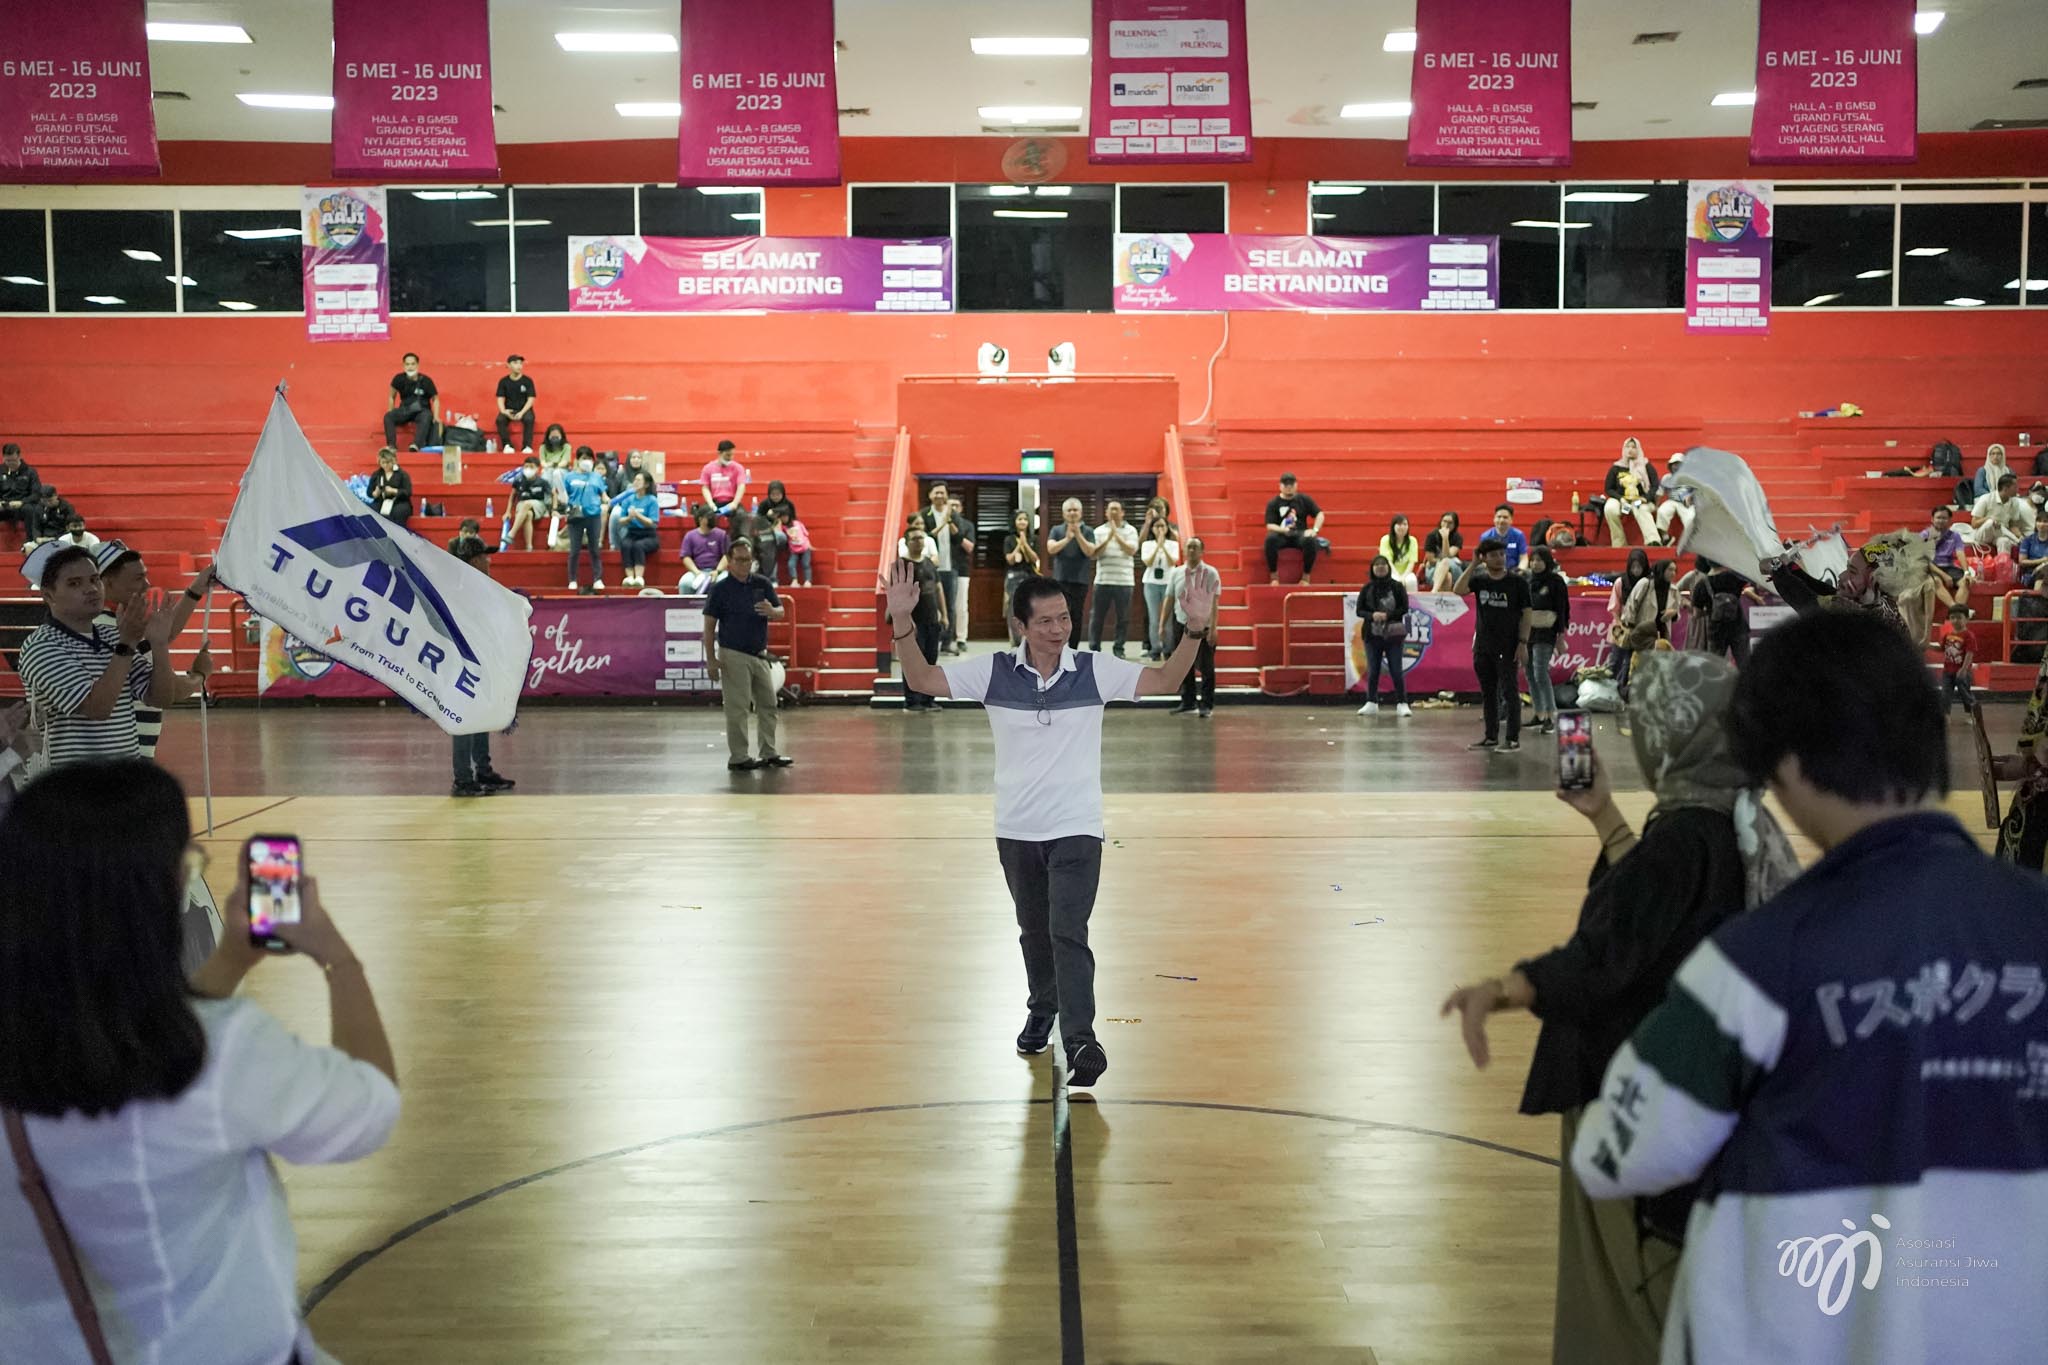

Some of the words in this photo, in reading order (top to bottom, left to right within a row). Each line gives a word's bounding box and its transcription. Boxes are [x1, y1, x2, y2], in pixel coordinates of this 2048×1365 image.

[1424, 54, 1435, 68] 6
[1441, 53, 1474, 67] MEI
[1492, 53, 1511, 67] 16
[1516, 53, 1558, 68] JUNI
[1766, 52, 1777, 66] 6
[1783, 51, 1816, 66] MEI
[1836, 50, 1854, 65] 16
[1860, 50, 1902, 64] JUNI
[4, 61, 15, 76] 6
[21, 61, 54, 76] MEI
[72, 61, 92, 76] 16
[97, 62, 141, 76] JUNI
[346, 63, 357, 78] 6
[363, 64, 396, 78] MEI
[415, 64, 433, 78] 16
[439, 64, 482, 79] JUNI
[693, 74, 703, 88] 6
[709, 74, 741, 88] MEI
[759, 73, 777, 88] 16
[783, 73, 825, 87] JUNI
[1468, 75, 1514, 89] 2023
[1811, 72, 1857, 87] 2023
[50, 83, 96, 98] 2023
[392, 86, 438, 100] 2023
[736, 95, 781, 110] 2023
[1790, 103, 1816, 111] HALL
[1836, 102, 1843, 110] B
[1451, 115, 1488, 123] GRAND
[1490, 115, 1528, 123] FUTSAL
[1794, 114, 1830, 122] GRAND
[1833, 113, 1872, 121] FUTSAL
[416, 127, 454, 135] FUTSAL
[717, 125, 742, 133] HALL
[1781, 125, 1799, 133] NYI
[1802, 125, 1838, 133] AGENG
[1841, 124, 1883, 132] SERANG
[84, 136, 127, 144] SERANG
[721, 136, 757, 144] GRAND
[1437, 137, 1473, 145] USMAR
[1477, 137, 1513, 145] ISMAIL
[1516, 137, 1542, 145] HALL
[1779, 136, 1816, 144] USMAR
[1860, 135, 1885, 143] HALL
[709, 147, 727, 155] NYI
[767, 146, 809, 154] SERANG
[1457, 148, 1495, 156] RUMAH
[1498, 148, 1521, 156] AAJI
[1840, 146, 1864, 154] AAJI
[707, 158, 743, 166] USMAR
[786, 157, 811, 165] HALL
[767, 168, 791, 176] AAJI
[702, 252, 821, 270] SELAMAT
[1248, 250, 1367, 268] SELAMAT
[678, 276, 842, 295] BERTANDING
[1224, 275, 1388, 293] BERTANDING
[271, 543, 480, 699] TUGURE
[545, 614, 569, 651] of
[350, 642, 375, 659] from
[378, 654, 405, 676] Trust
[405, 673, 415, 684] to
[530, 639, 611, 688] gether
